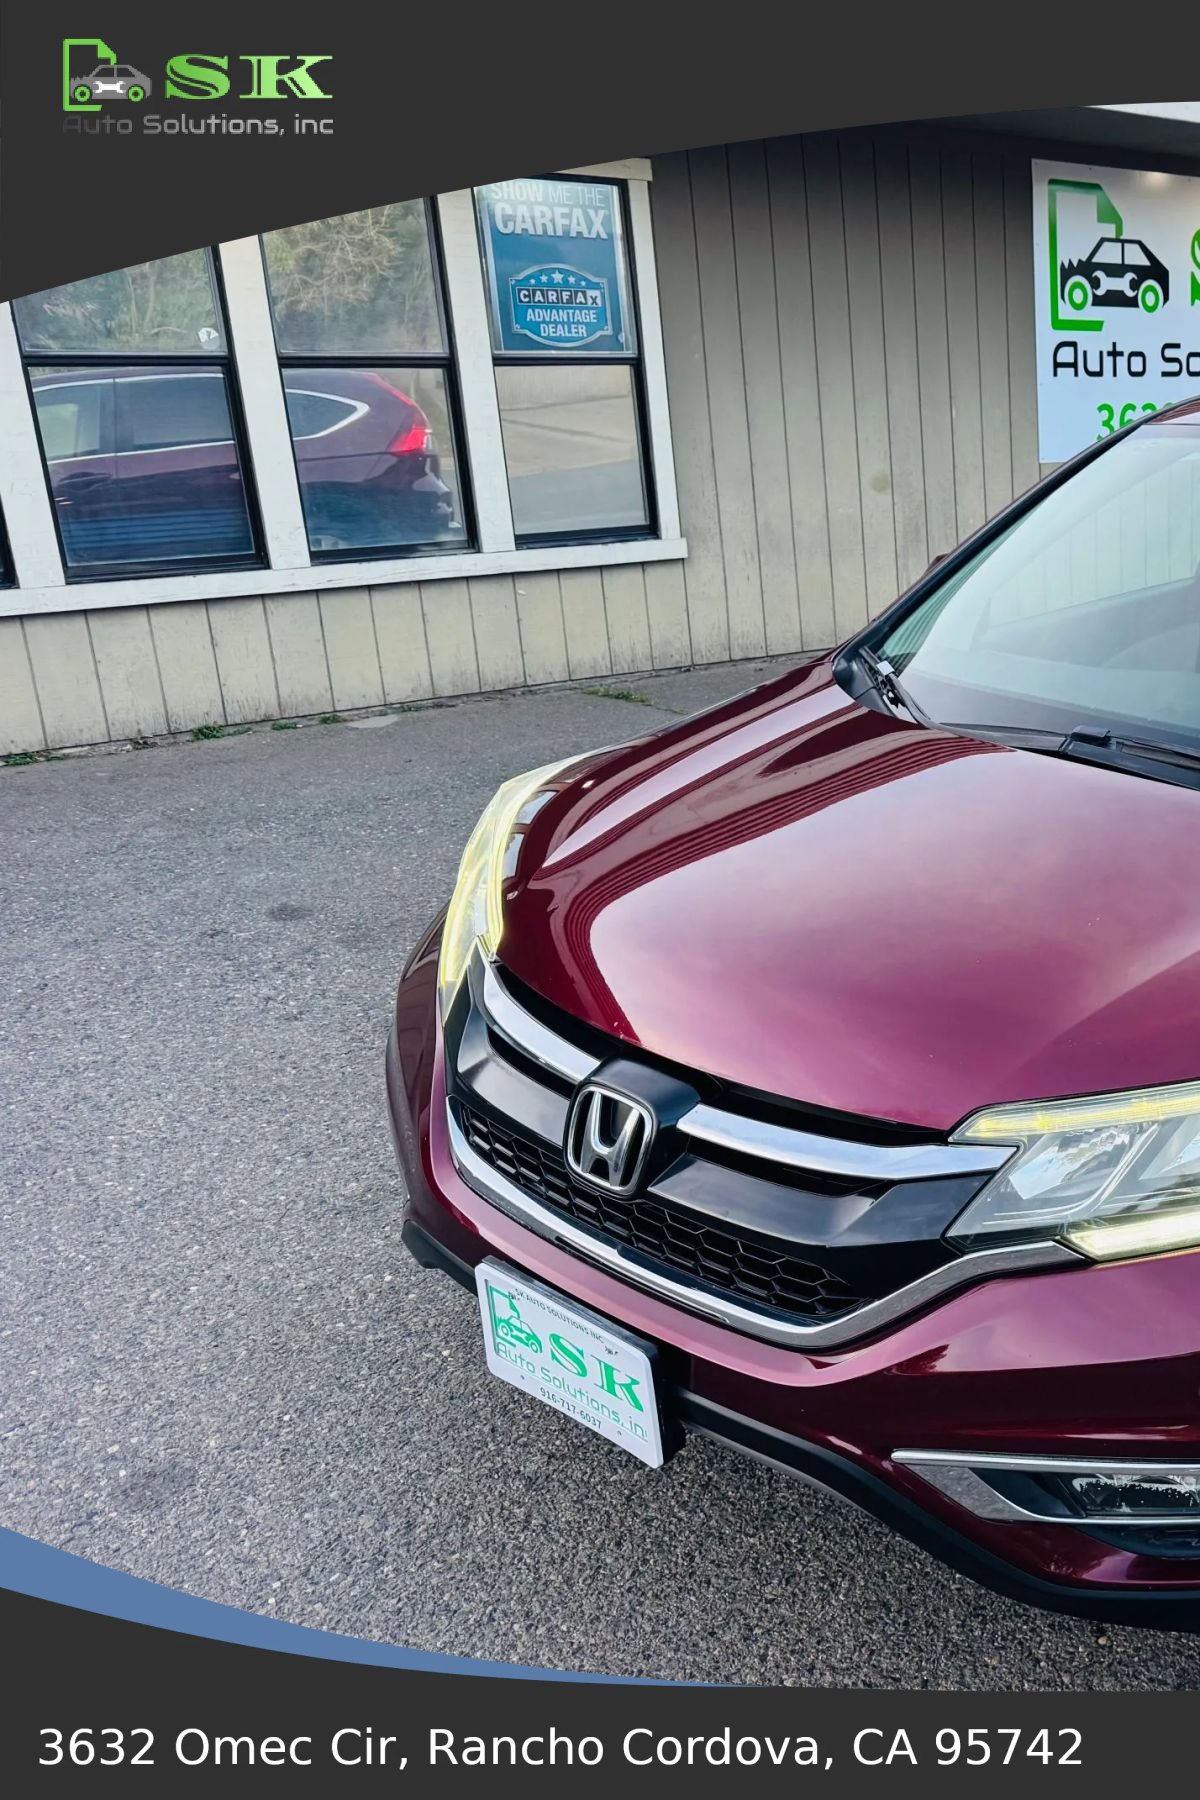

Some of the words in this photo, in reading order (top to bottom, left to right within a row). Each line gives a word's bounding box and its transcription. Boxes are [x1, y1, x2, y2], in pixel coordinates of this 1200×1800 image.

[491, 182, 543, 201] SHOW
[548, 185, 573, 204] ME
[577, 186, 606, 207] THE
[494, 202, 608, 239] CARFAX
[519, 289, 599, 306] CARFAX
[526, 308, 597, 323] ADVANTAGE
[540, 323, 587, 337] DEALER
[1053, 341, 1147, 377] Auto
[1096, 402, 1175, 441] 36
[496, 1341, 536, 1374] Auto
[549, 1333, 644, 1412] SK
[540, 1386, 602, 1429] 916-717-6037
